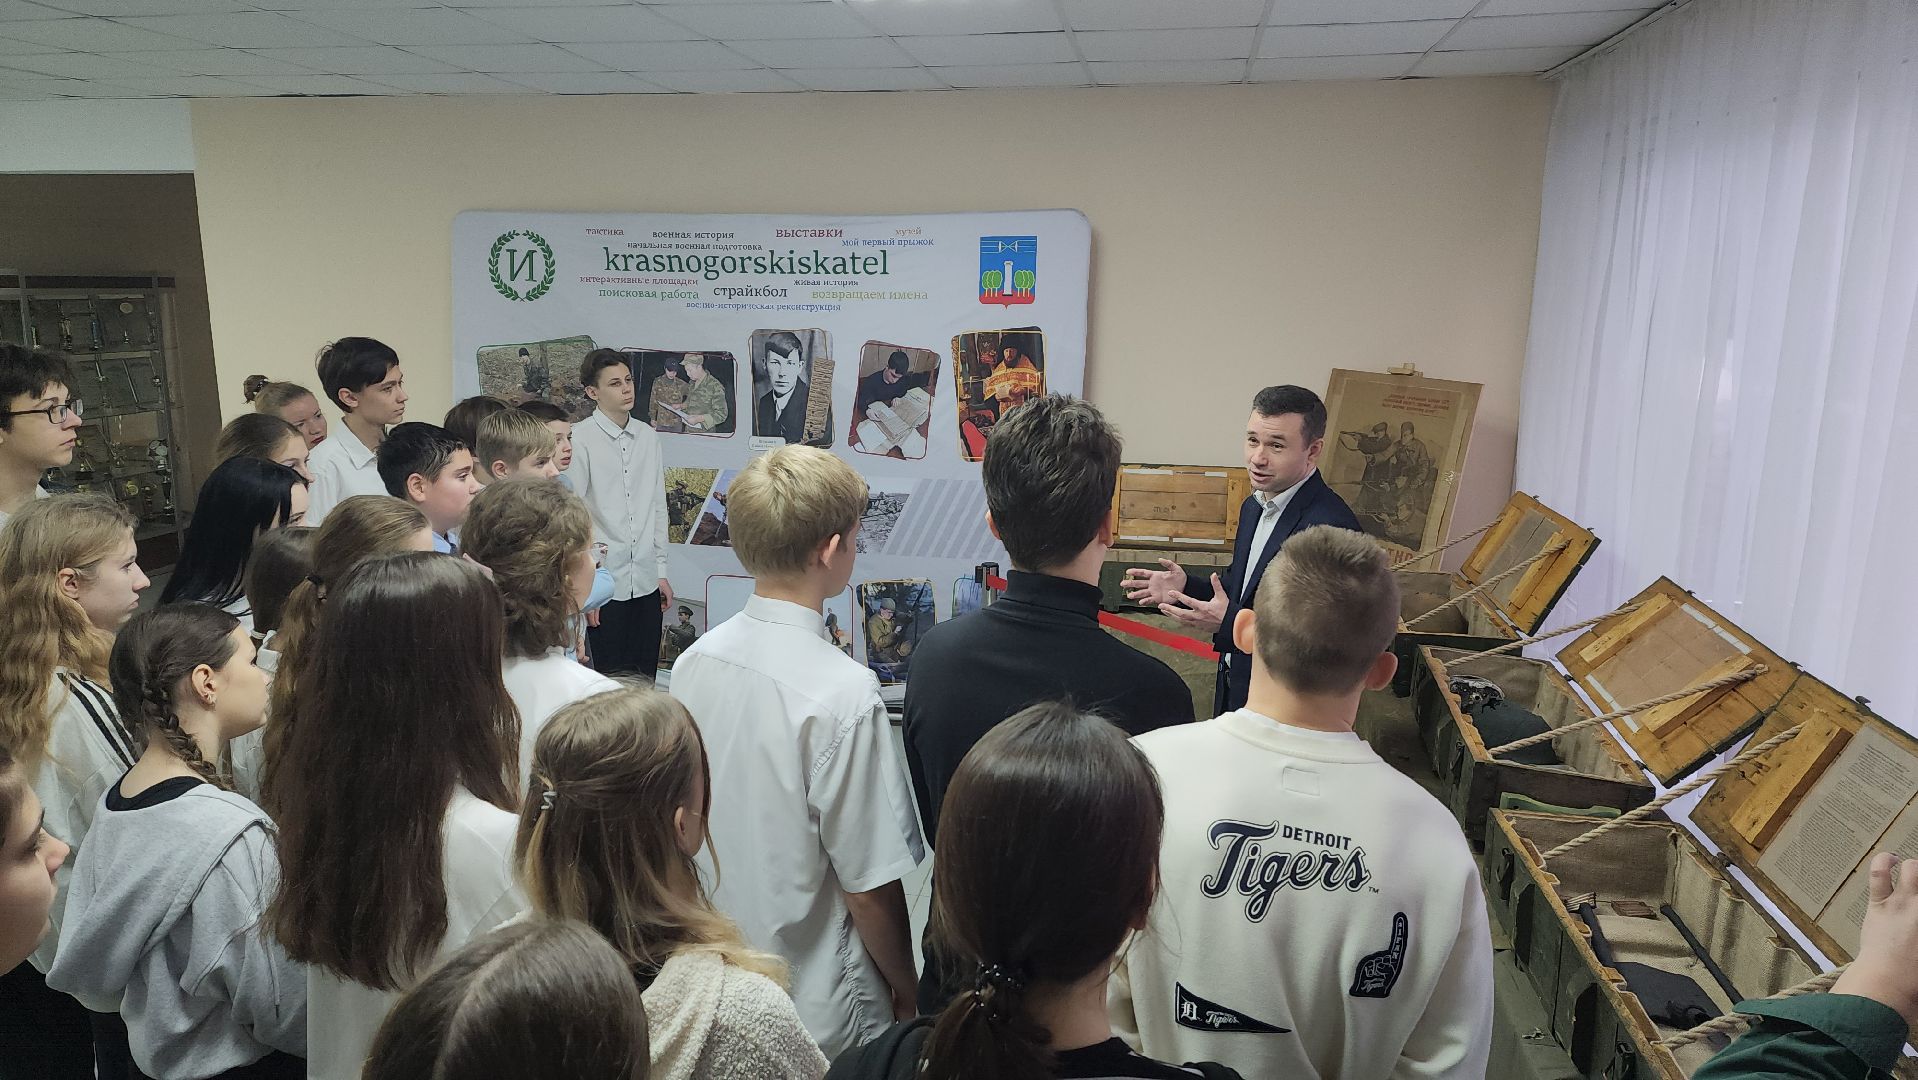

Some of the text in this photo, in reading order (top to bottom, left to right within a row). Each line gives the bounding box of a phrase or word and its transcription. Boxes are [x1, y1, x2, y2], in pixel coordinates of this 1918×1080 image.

[585, 227, 625, 236] тактика
[652, 231, 734, 241] военная история
[775, 228, 843, 238] выставки
[842, 238, 934, 248] мой первый прыжок
[505, 248, 538, 282] И
[602, 246, 890, 281] krasnogorskiskatel
[652, 276, 699, 286] площадки
[793, 278, 859, 288] живая история
[599, 288, 700, 301] поисковая работа
[713, 283, 788, 299] страйкбол
[811, 289, 929, 301] возвращаем имена
[1282, 824, 1352, 851] DETROIT
[1201, 819, 1372, 923] Tigers
